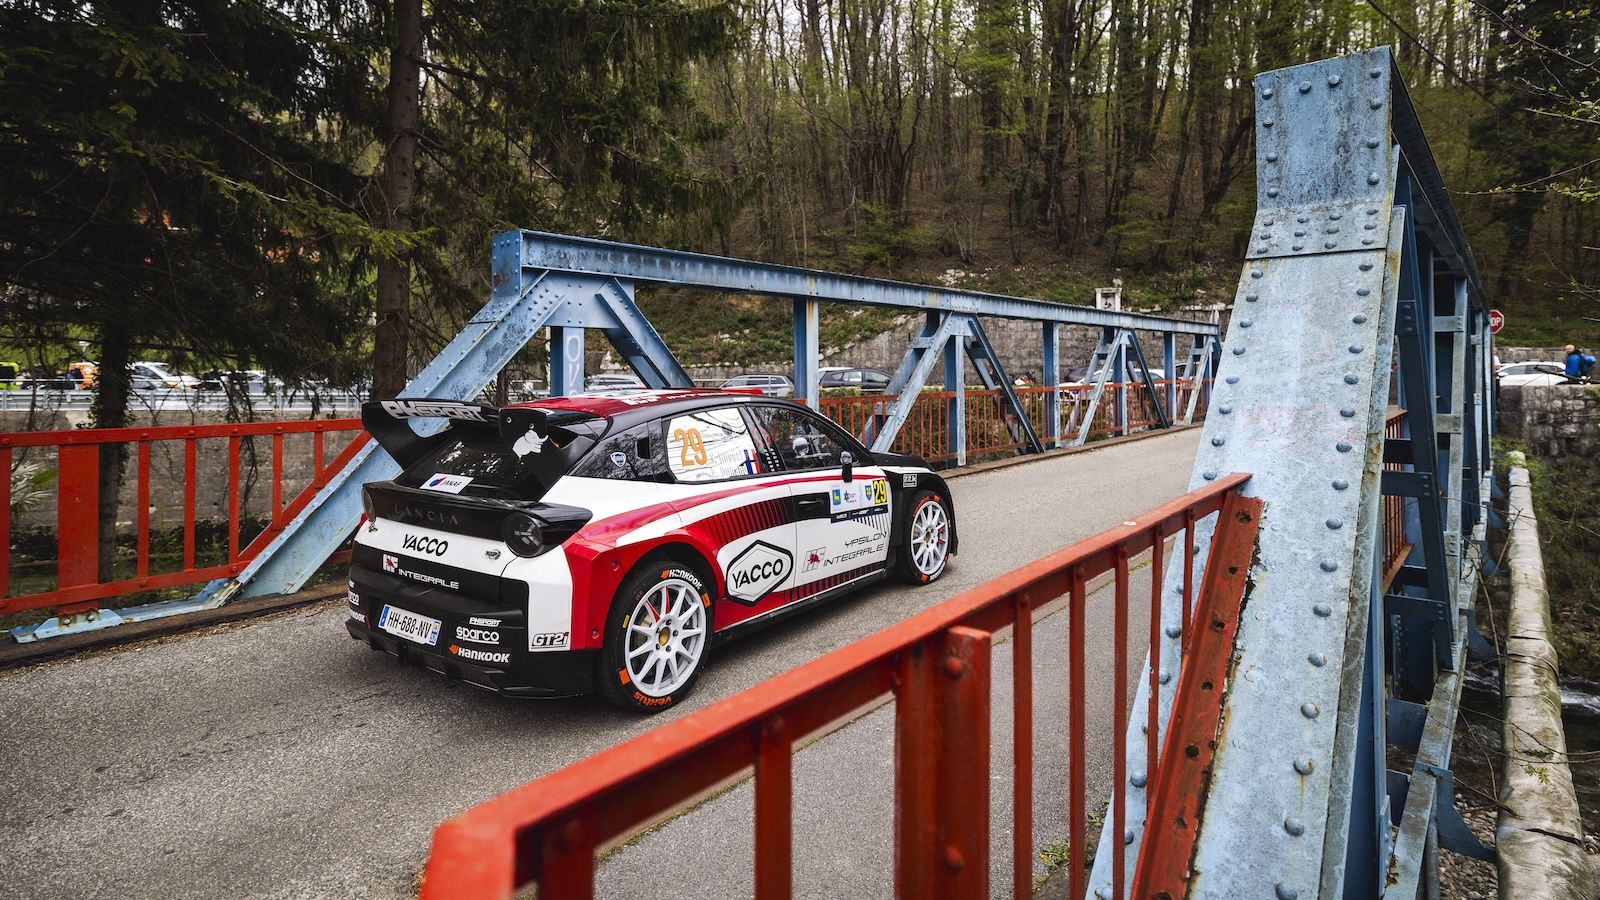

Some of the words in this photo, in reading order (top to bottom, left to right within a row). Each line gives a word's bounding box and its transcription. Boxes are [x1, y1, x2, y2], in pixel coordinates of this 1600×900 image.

[674, 427, 708, 467] 29
[873, 480, 888, 504] 29
[394, 504, 459, 525] LANCIA
[402, 533, 449, 557] YACCO
[844, 531, 887, 548] YPSILON
[823, 543, 885, 567] INTEGRALE
[399, 568, 460, 590] INTEGRALE
[732, 558, 783, 589] YACCO
[386, 610, 432, 639] HH-688-NV
[456, 626, 500, 642] sparco
[531, 632, 570, 647] GT2i
